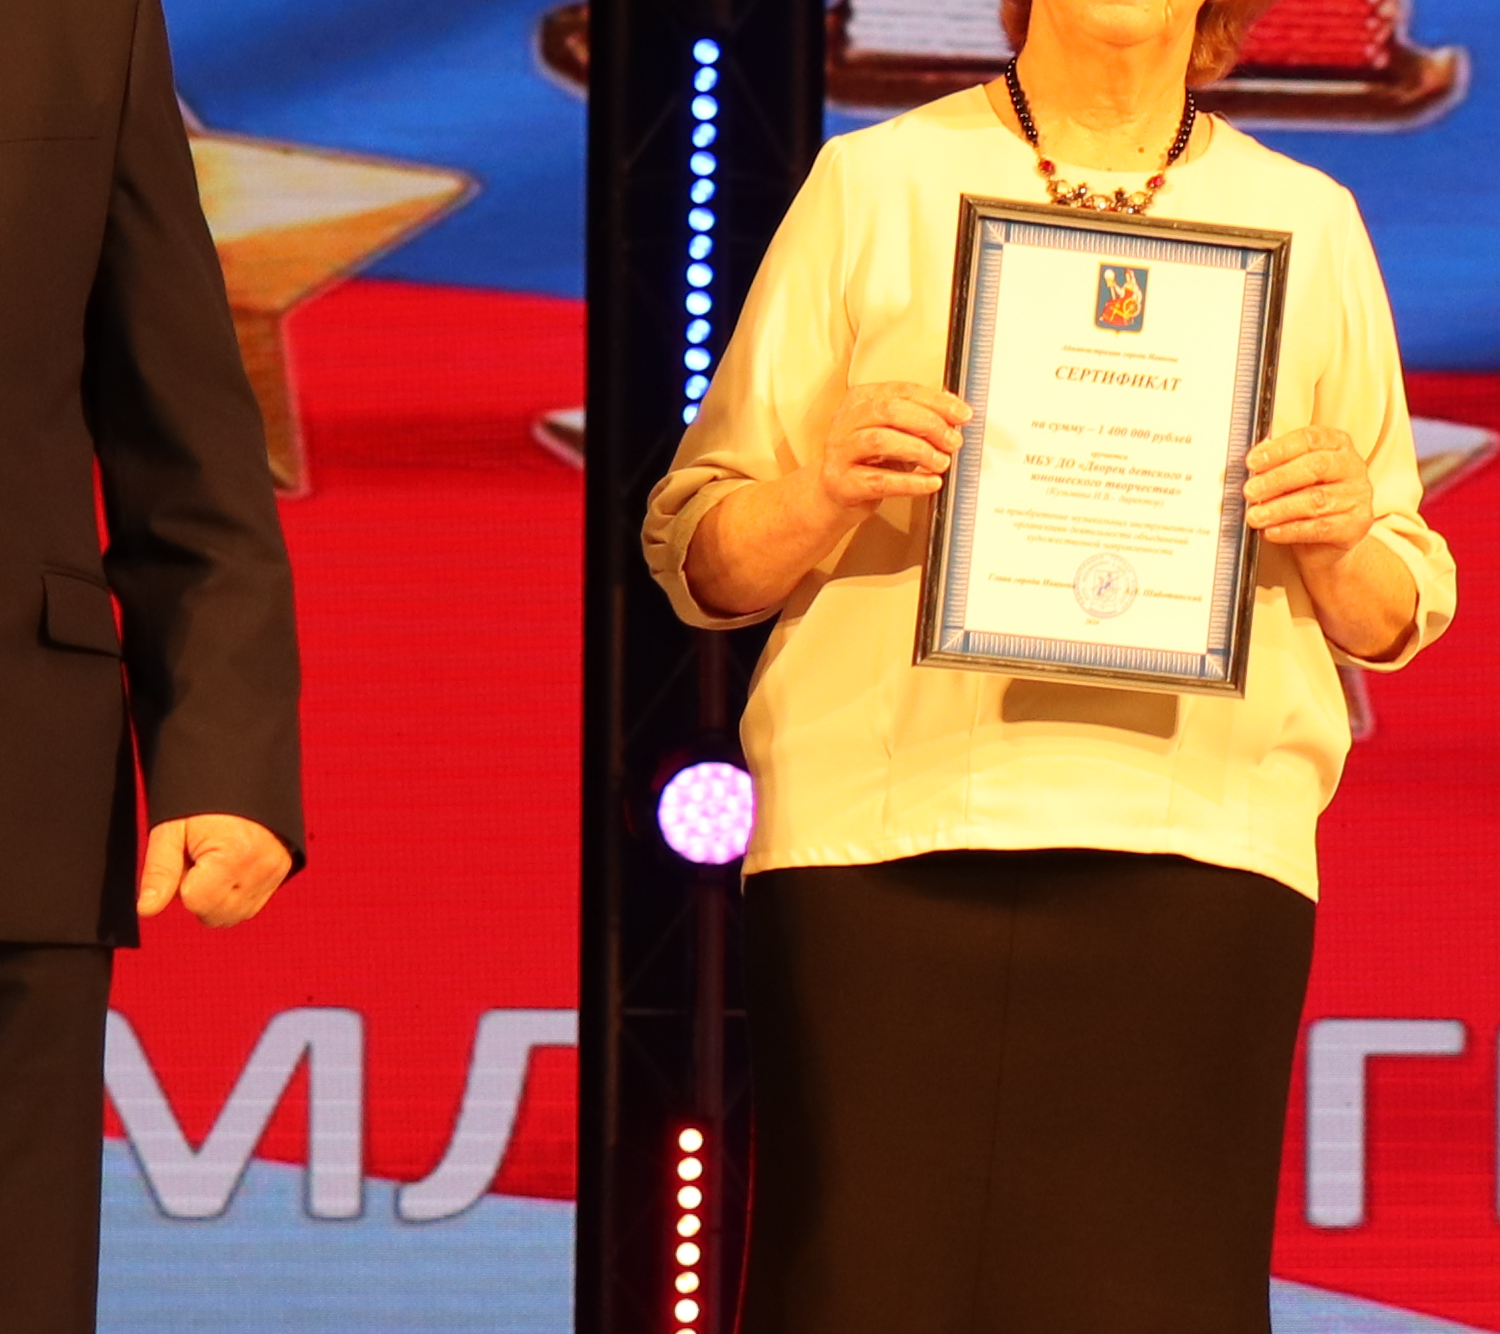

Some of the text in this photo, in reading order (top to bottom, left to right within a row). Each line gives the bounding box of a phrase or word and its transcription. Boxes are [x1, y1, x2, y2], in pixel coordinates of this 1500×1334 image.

[1054, 366, 1181, 390] СЕРТИФИКАТ
[1047, 422, 1084, 433] сумму
[1106, 426, 1128, 436] 400
[1129, 428, 1151, 437] 000
[1150, 432, 1192, 443] рублей
[1024, 454, 1051, 465] МБУ
[1128, 466, 1182, 479] детского
[1030, 473, 1102, 486] юношеского
